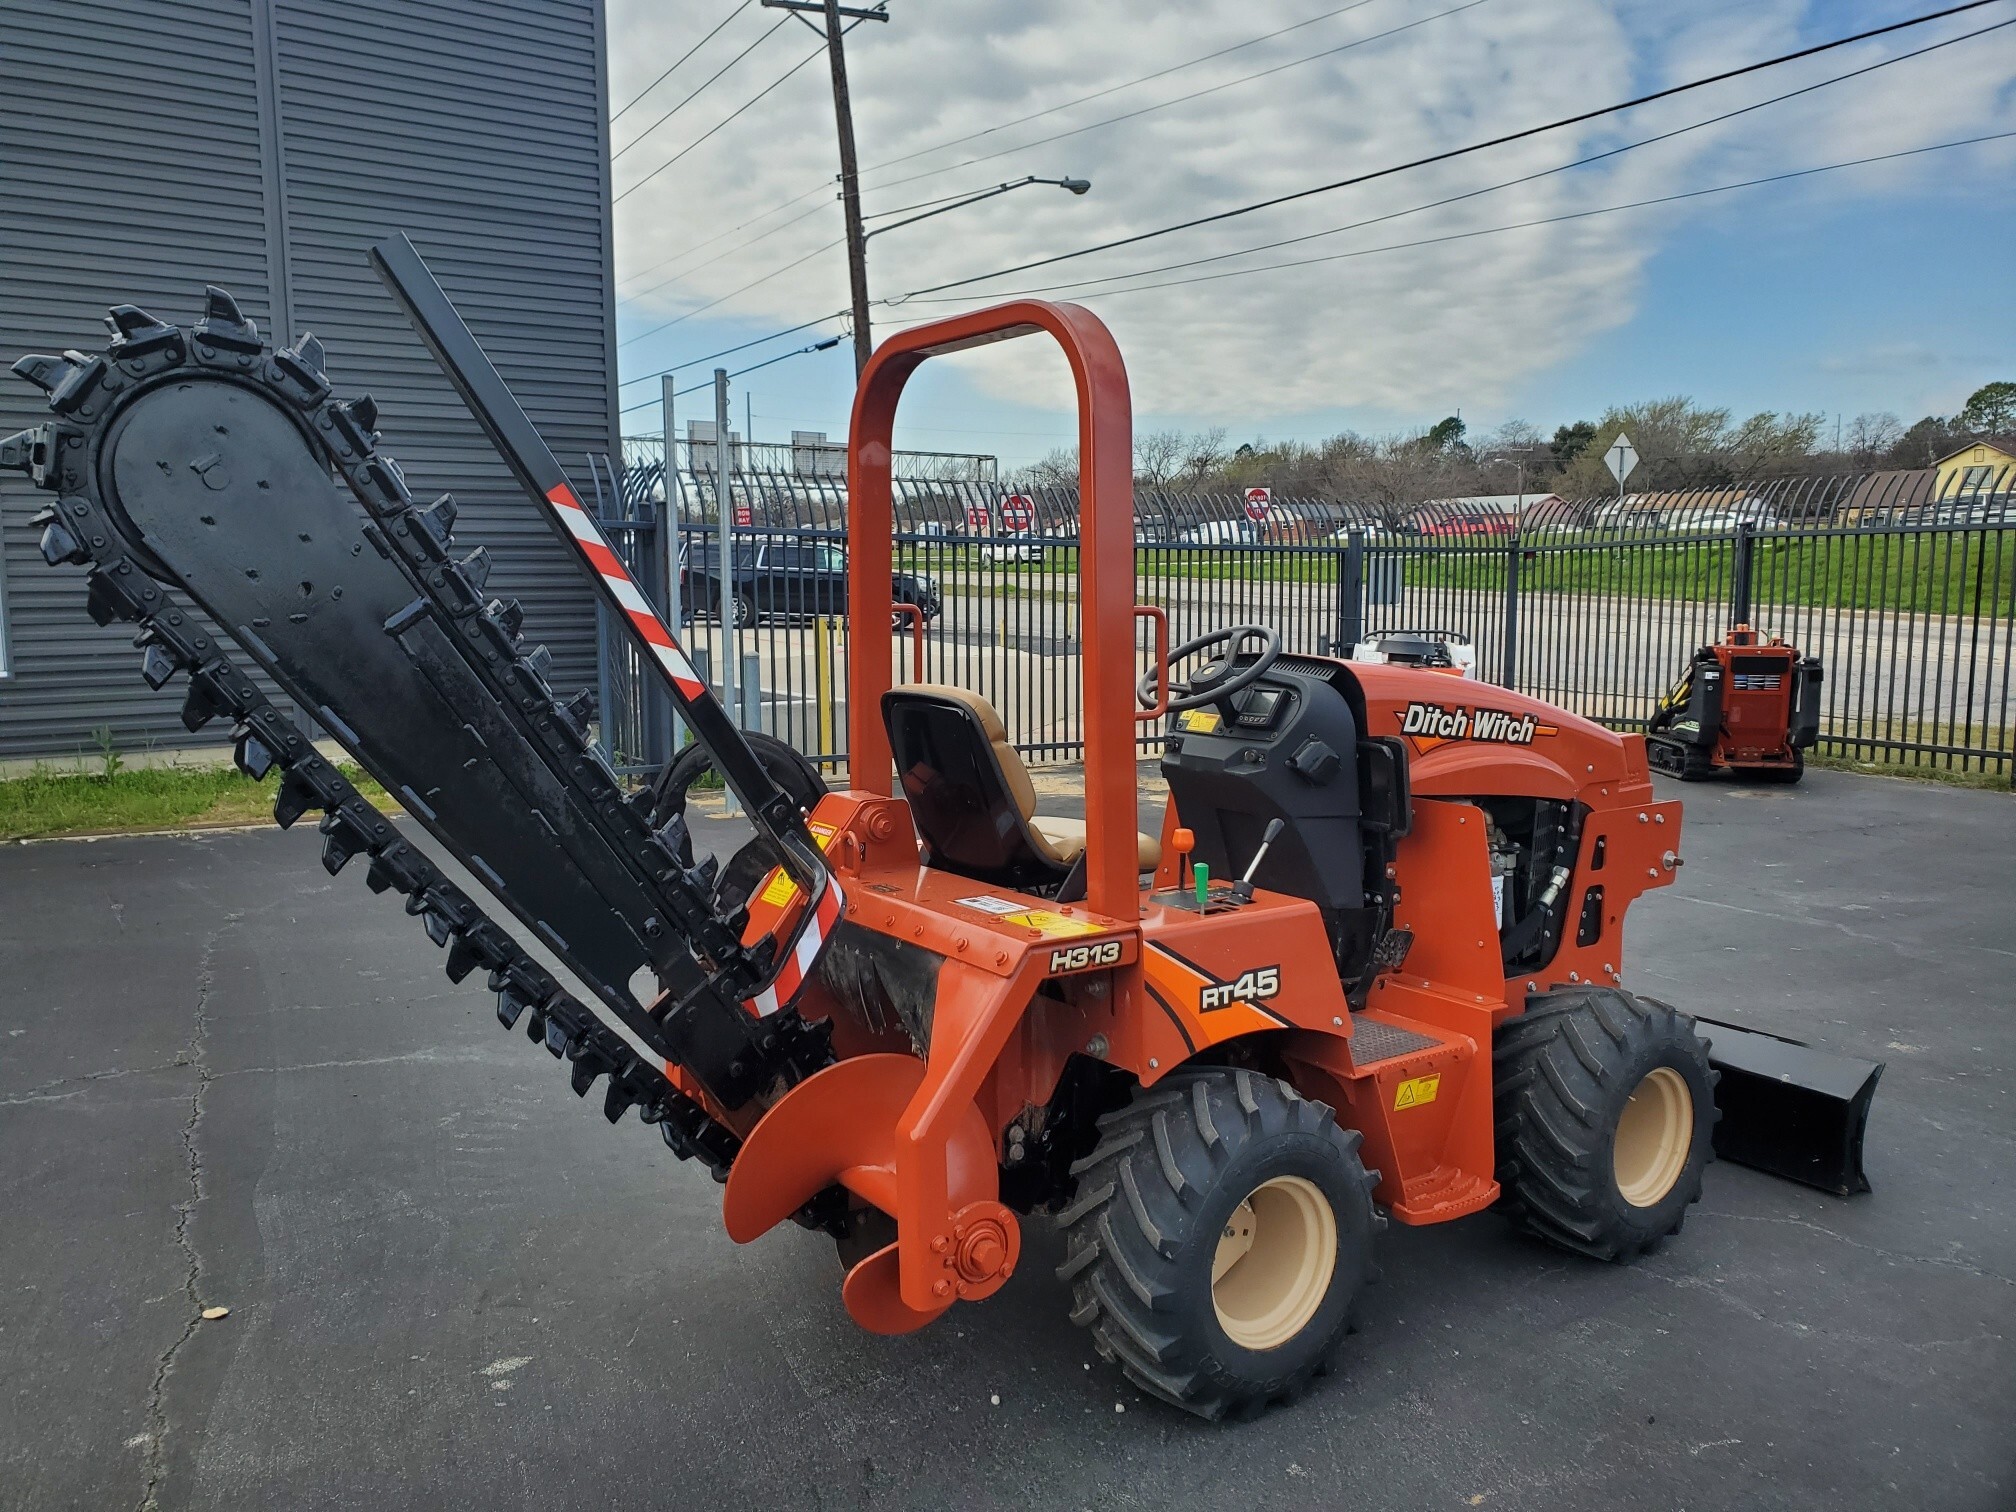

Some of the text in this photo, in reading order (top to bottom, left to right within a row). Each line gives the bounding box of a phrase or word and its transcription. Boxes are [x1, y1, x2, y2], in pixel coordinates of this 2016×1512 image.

[1403, 704, 1534, 743] Ditch Witch
[1051, 942, 1119, 972] H313
[1202, 968, 1278, 1009] RT45
